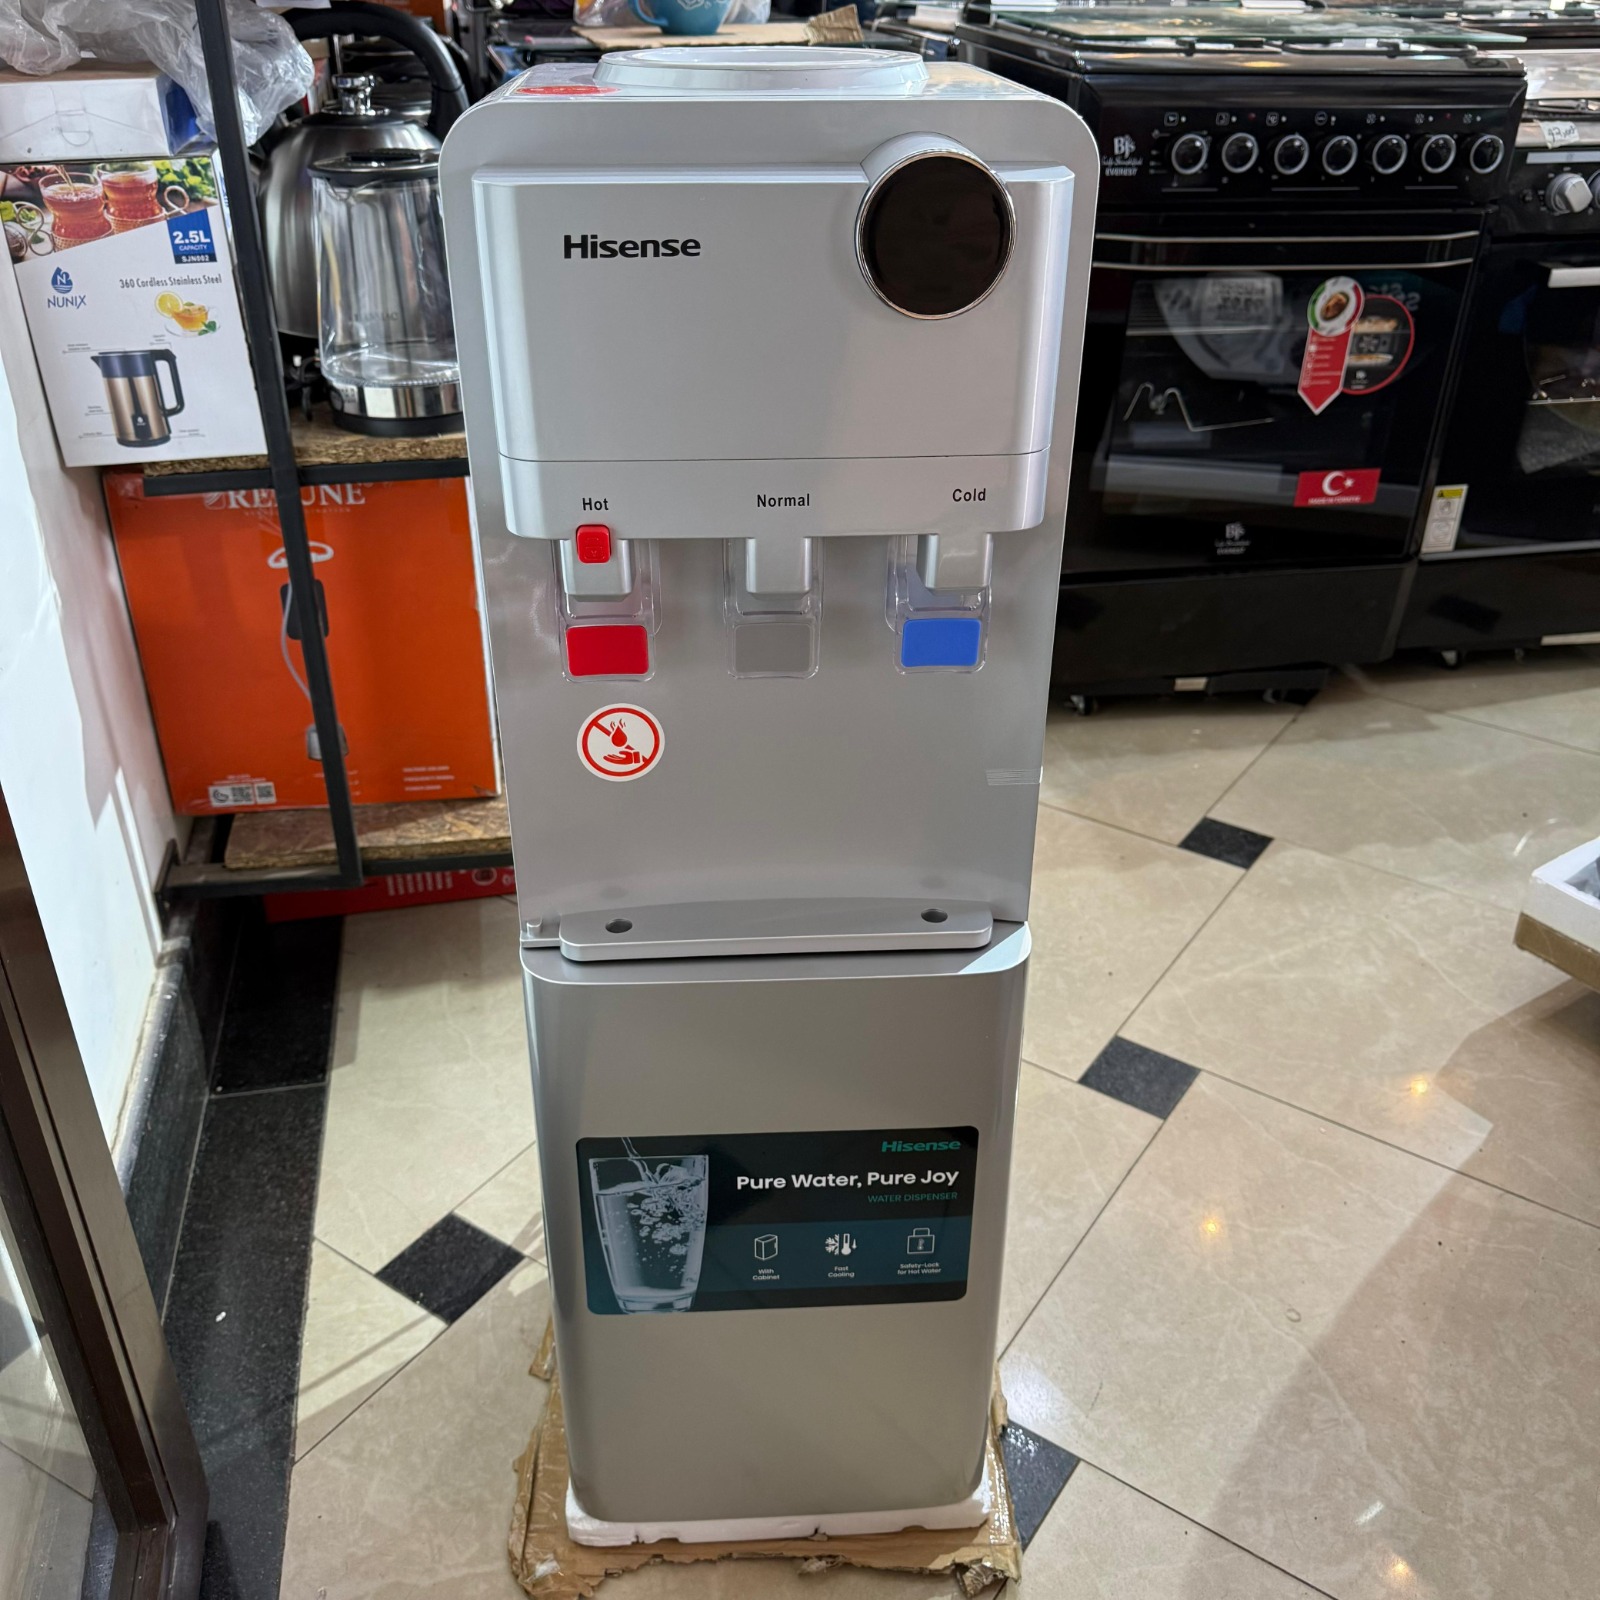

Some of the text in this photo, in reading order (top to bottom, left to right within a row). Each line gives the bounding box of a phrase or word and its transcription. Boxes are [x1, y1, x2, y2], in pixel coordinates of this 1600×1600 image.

[172, 229, 211, 244] 2.5L
[563, 234, 702, 259] Hisense
[119, 273, 222, 289] 360 Cordless Stainless Steel
[47, 294, 87, 310] NUNIX
[227, 482, 367, 509] REUNE
[756, 492, 811, 509] Normal
[952, 487, 987, 503] Cold
[582, 497, 609, 511] Hot
[881, 1140, 961, 1153] Hisense
[736, 1169, 960, 1190] Pure Water, Pure Joy
[867, 1192, 958, 1203] WATER DISPENSER
